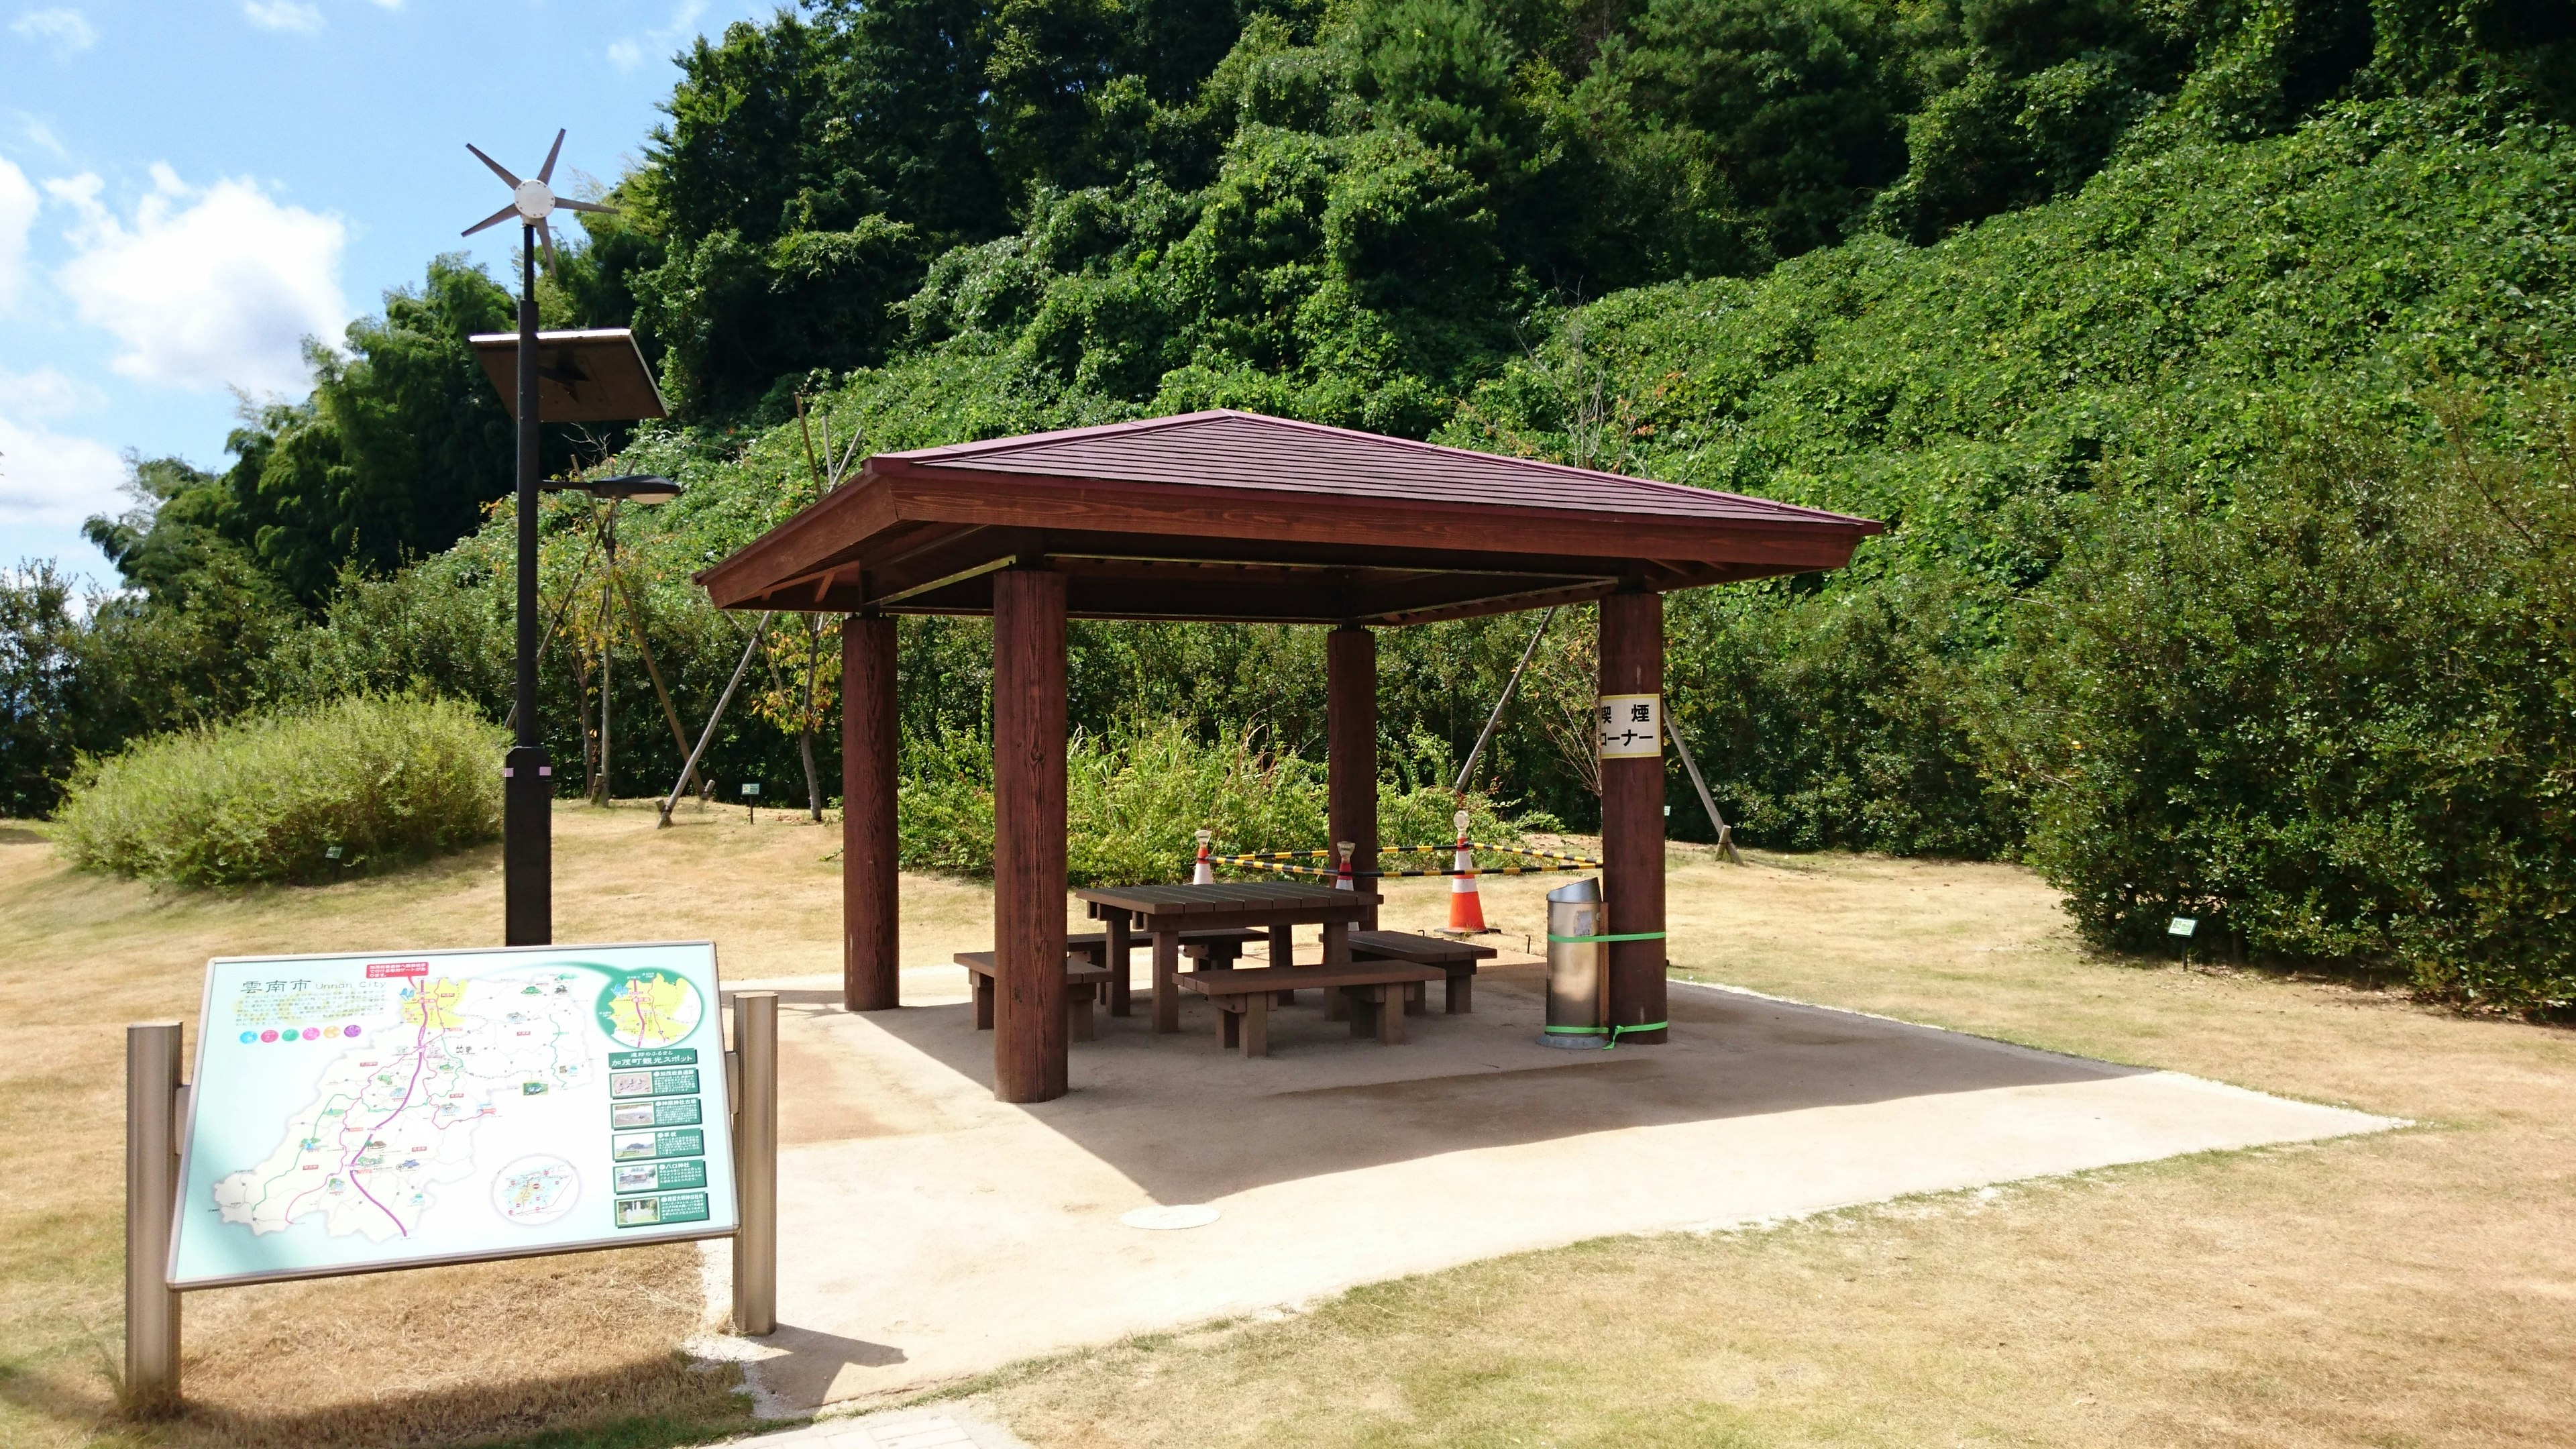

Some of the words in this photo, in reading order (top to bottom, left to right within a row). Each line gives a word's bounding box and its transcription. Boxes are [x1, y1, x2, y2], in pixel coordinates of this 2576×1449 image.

[240, 979, 311, 994] 雲南市
[359, 981, 386, 989] City
[612, 1055, 692, 1066] 加茂町観光スポット
